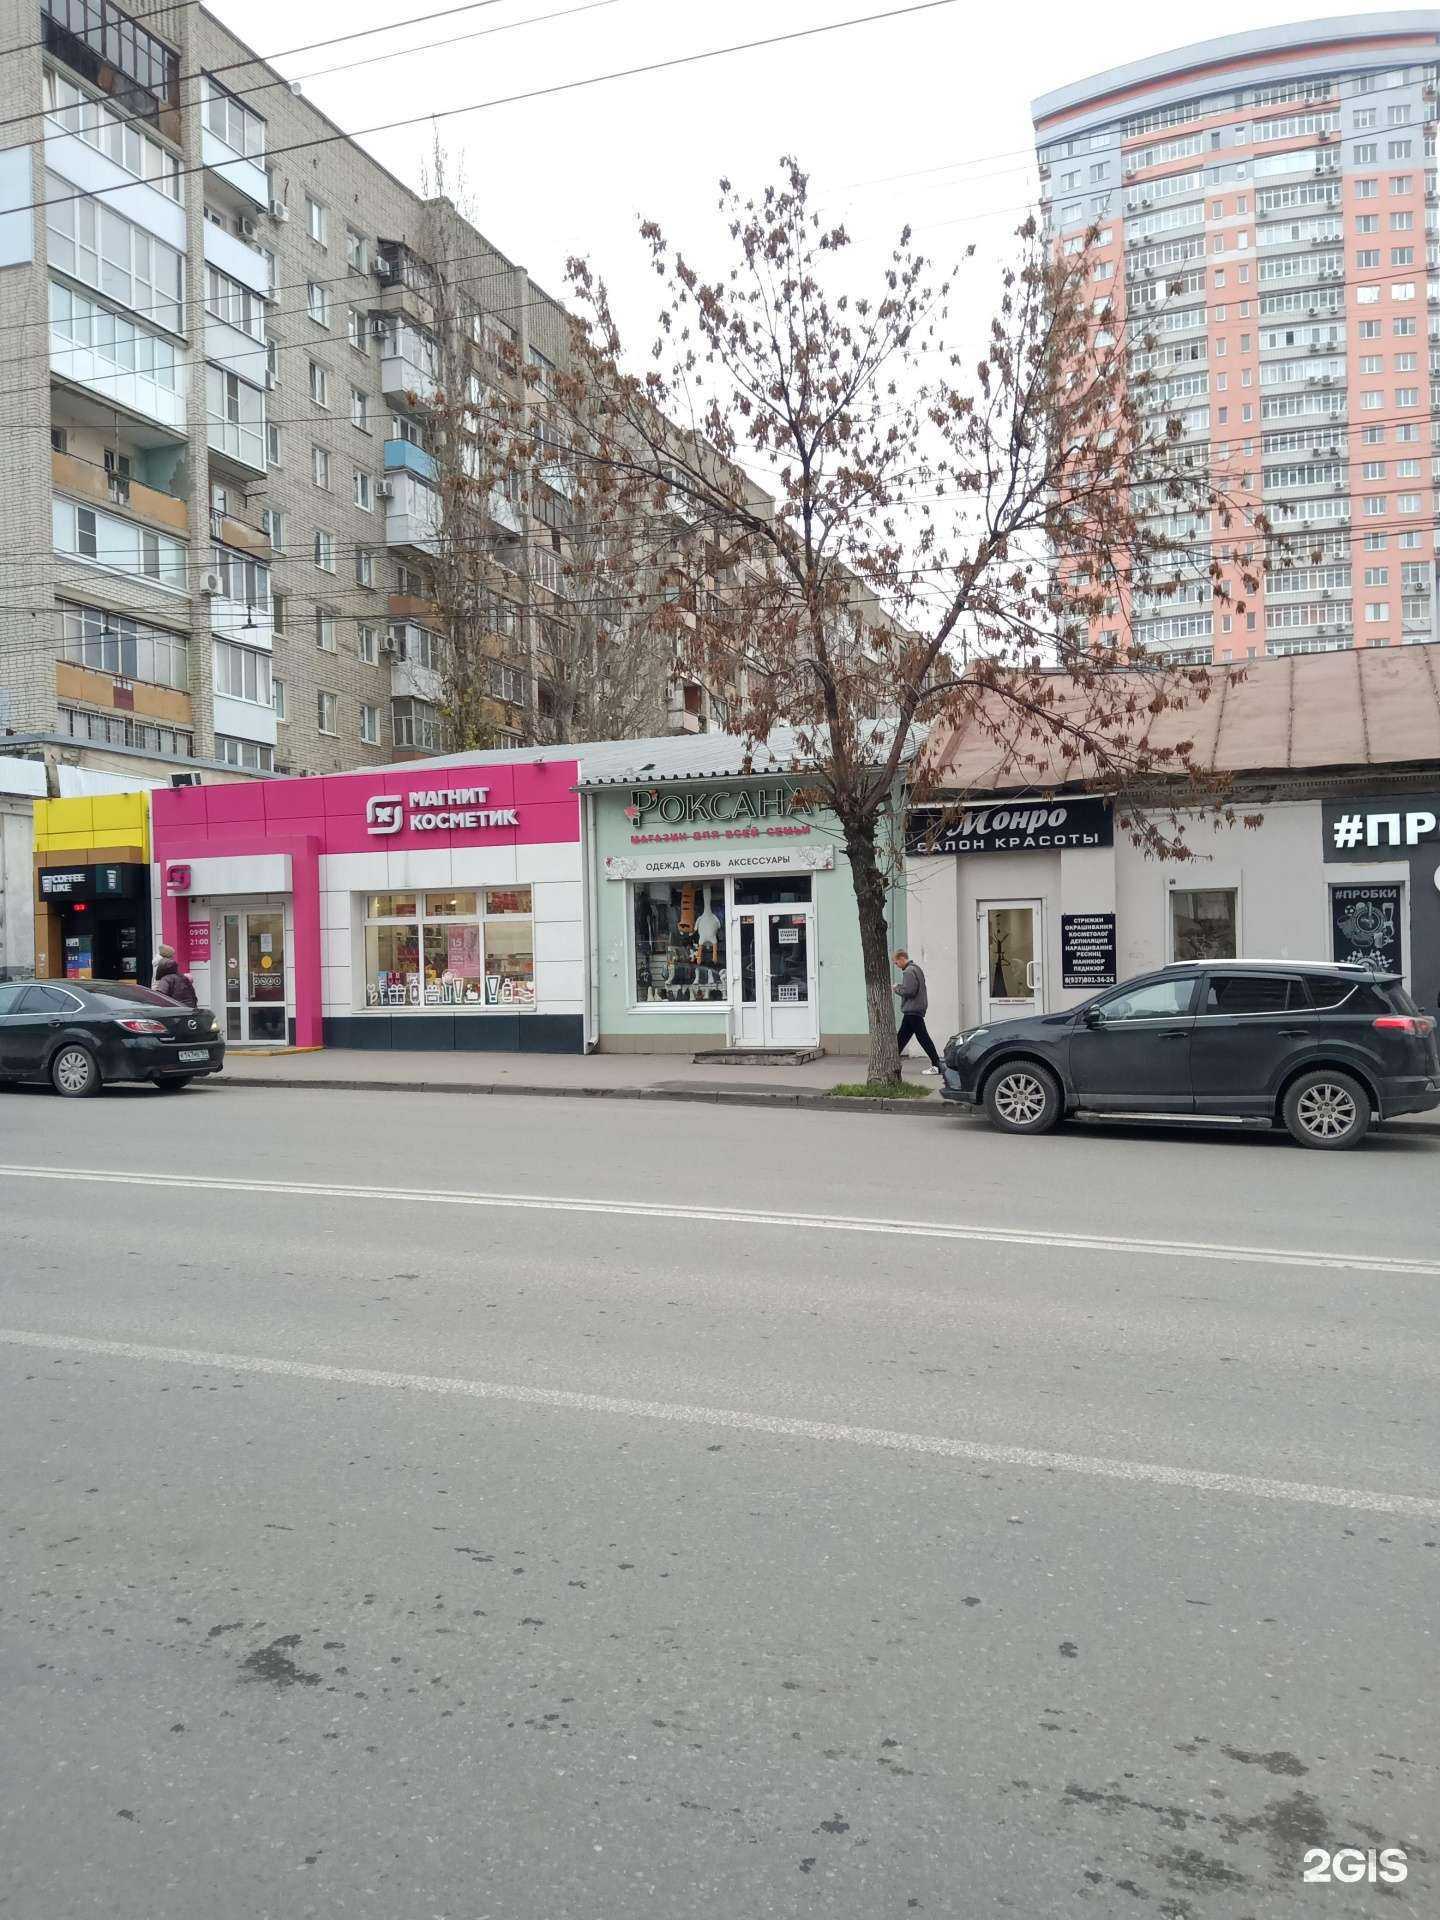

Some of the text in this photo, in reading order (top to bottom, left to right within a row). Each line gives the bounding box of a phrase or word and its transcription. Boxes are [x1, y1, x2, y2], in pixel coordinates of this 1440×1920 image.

[409, 787, 490, 808] МАГНИТ
[631, 788, 811, 828] РОКСАНА
[410, 809, 520, 831] КОСМЕТИК
[947, 808, 1067, 836] Монро
[1333, 812, 1440, 848] #ПР
[631, 825, 811, 845] МАГАЗИН ДЛЯ ВСЕЙ СЕМЬИ
[917, 833, 1098, 852] САЛОН КРАСОТЫ
[645, 856, 791, 872] ОДЕЖДА ОБУВЬ АКСЕССУАРЫ
[52, 873, 86, 883] COFFEE
[52, 883, 72, 892] LIKE
[1335, 889, 1397, 899] #ПРОБКИ
